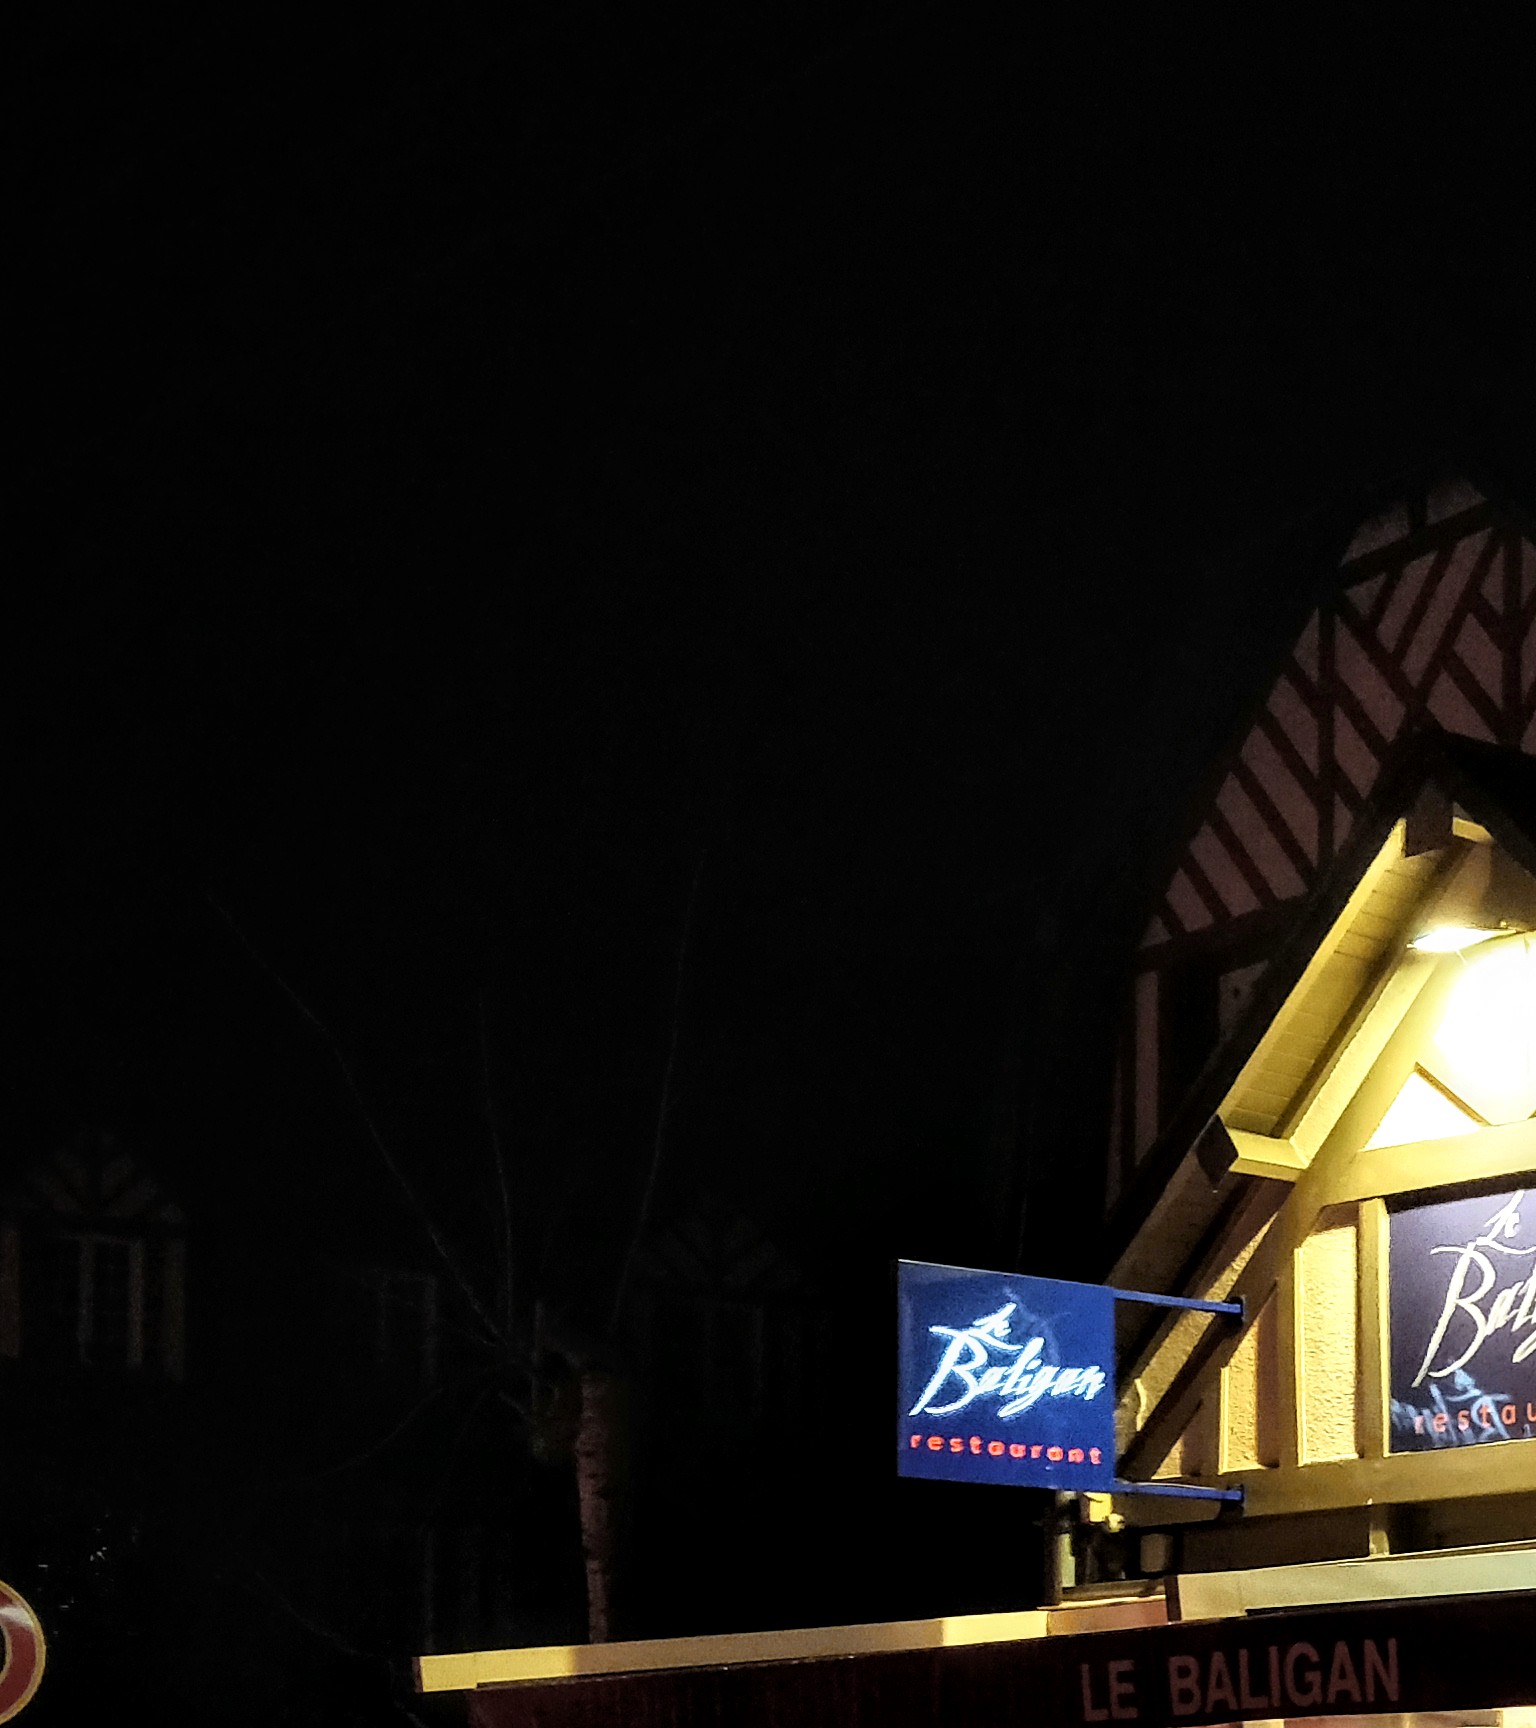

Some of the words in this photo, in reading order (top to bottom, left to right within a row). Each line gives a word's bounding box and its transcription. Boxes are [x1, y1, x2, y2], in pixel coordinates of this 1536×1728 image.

[908, 1325, 1107, 1418] Baligan
[909, 1433, 1102, 1465] restaurant
[1079, 1658, 1139, 1722] LE
[1167, 1637, 1401, 1718] BALIGAN
